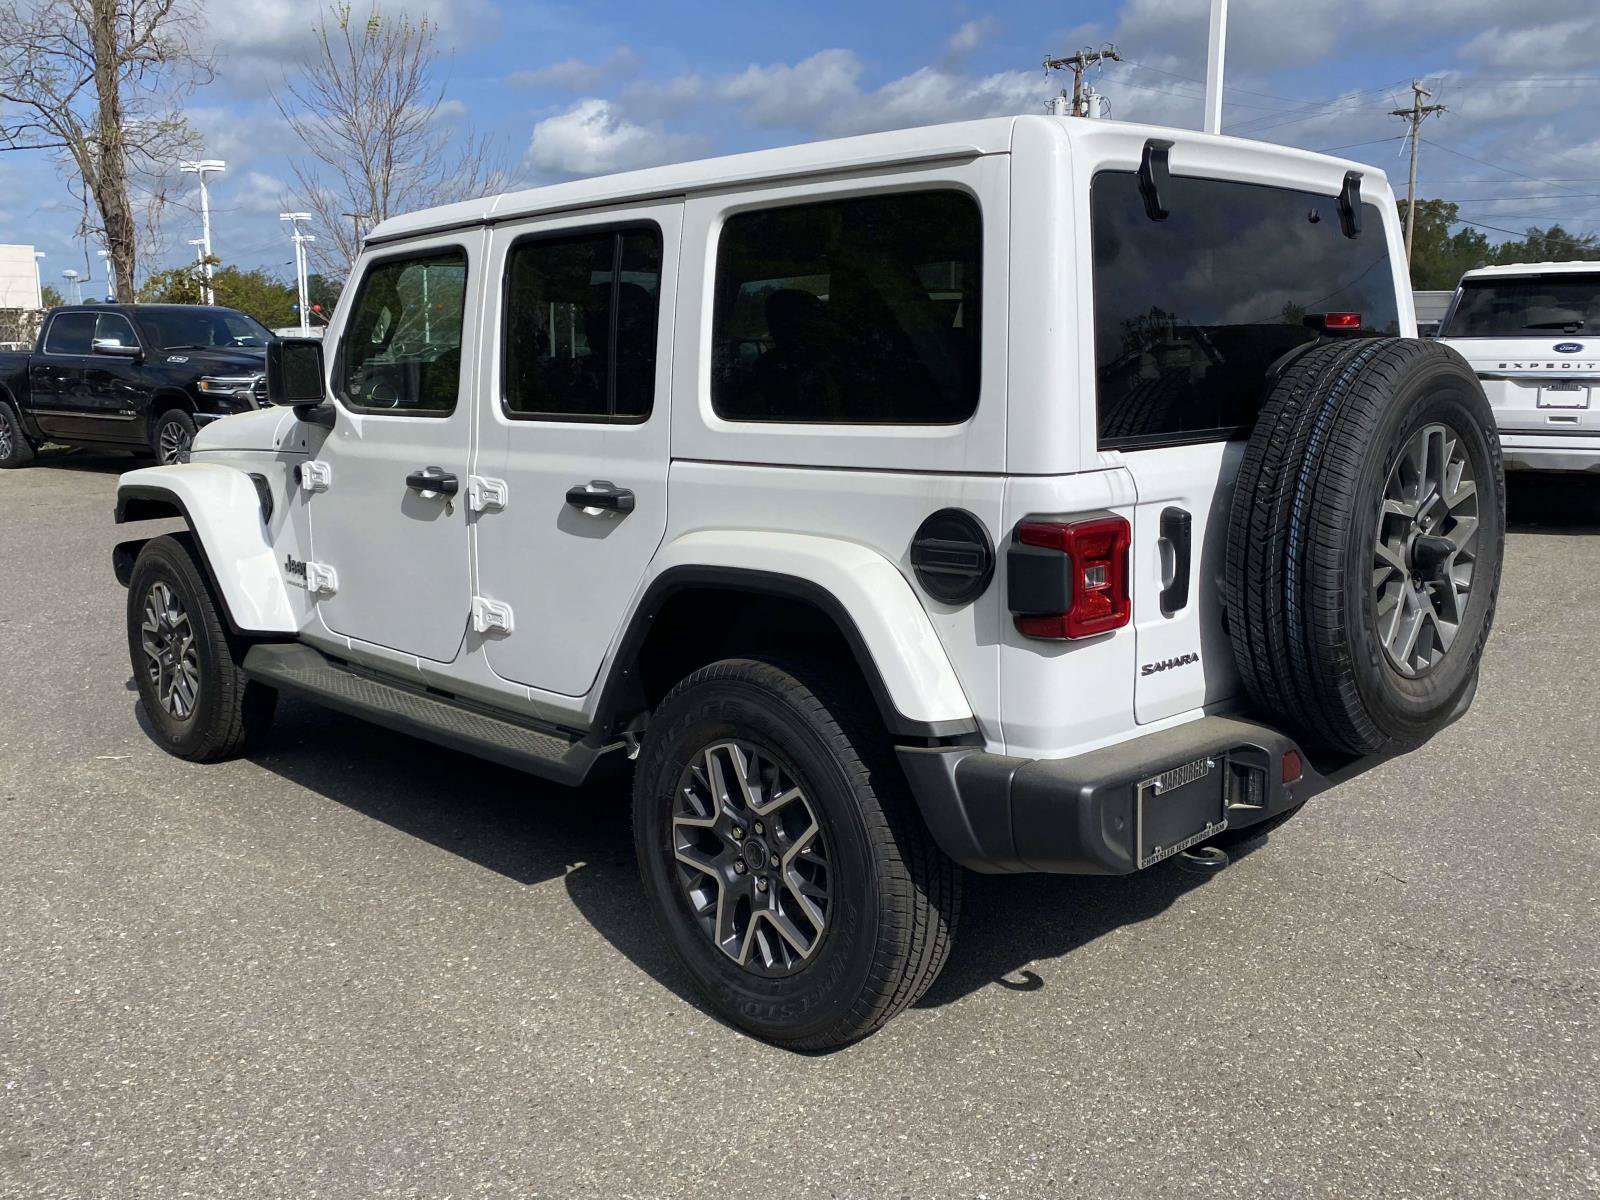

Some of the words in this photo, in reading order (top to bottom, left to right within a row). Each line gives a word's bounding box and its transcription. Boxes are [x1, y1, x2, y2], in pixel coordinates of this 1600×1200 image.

[1141, 652, 1199, 676] SAHARA
[1141, 847, 1175, 868] CHRYSLER
[1176, 840, 1190, 852] JEEP
[1190, 829, 1210, 845] DODGE
[1211, 823, 1225, 835] RAM
